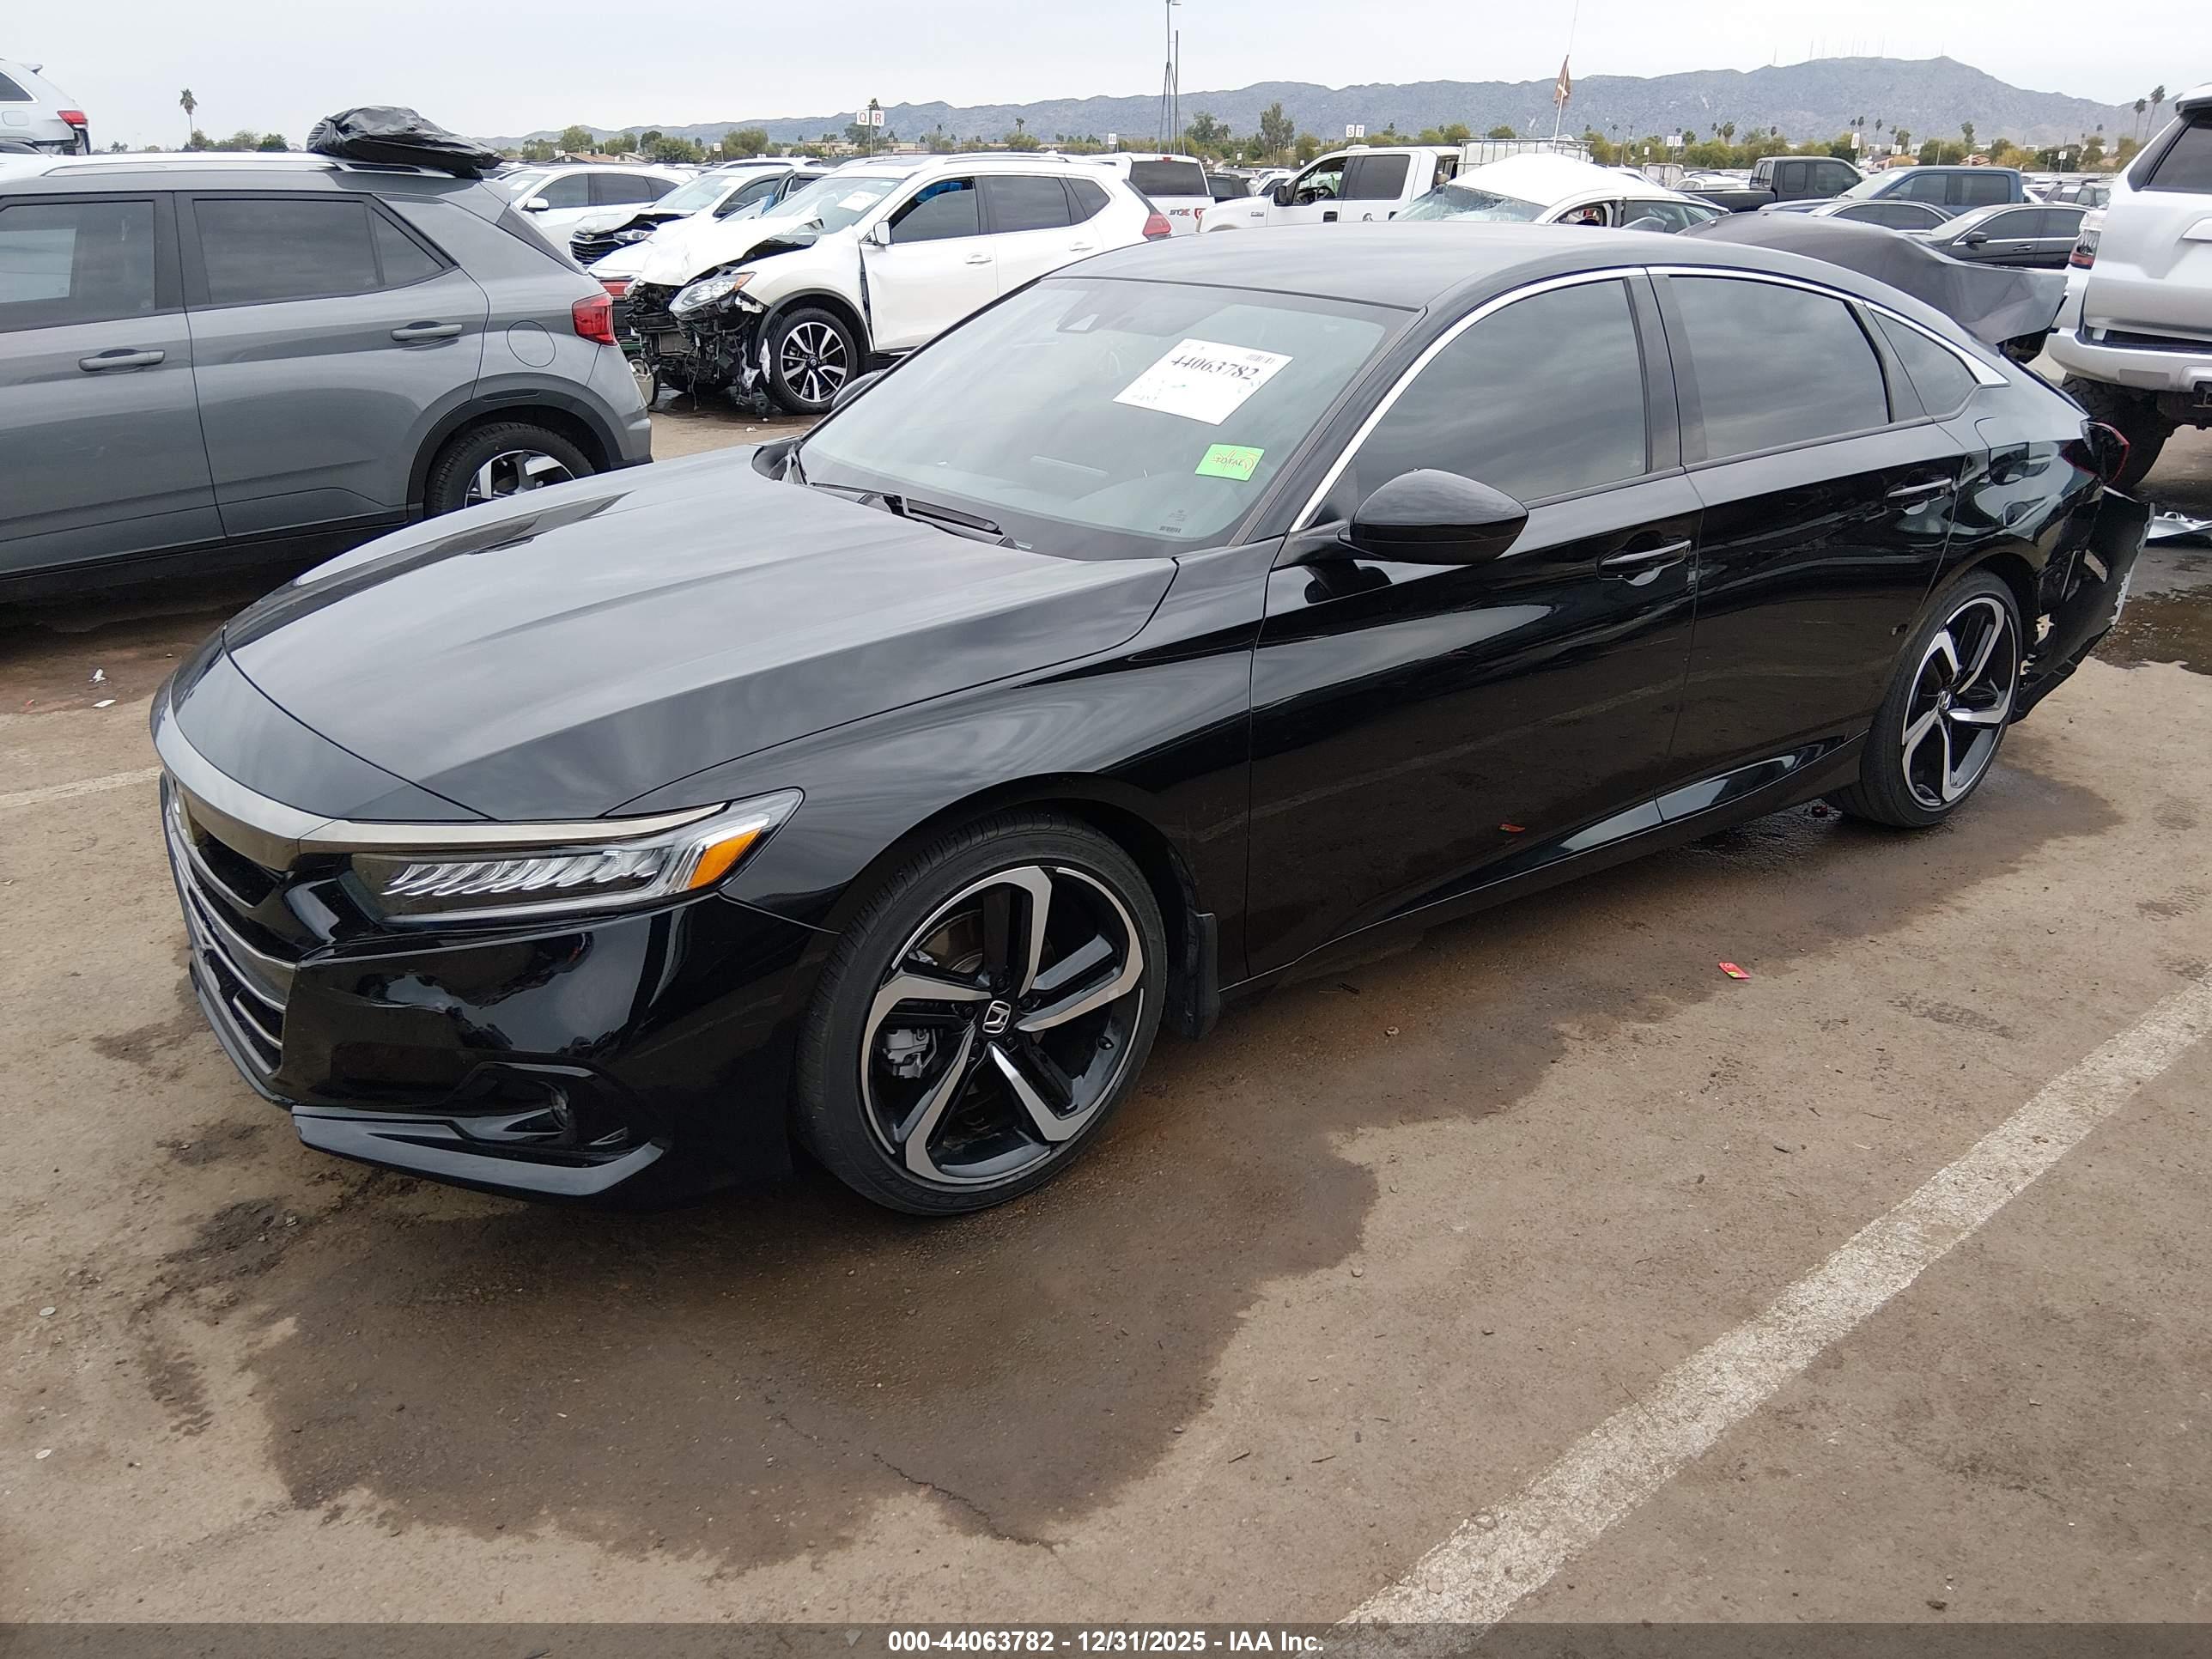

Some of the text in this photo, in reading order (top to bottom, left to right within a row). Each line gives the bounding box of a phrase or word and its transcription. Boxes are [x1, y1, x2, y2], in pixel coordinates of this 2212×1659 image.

[860, 112, 882, 125] Q R
[1170, 355, 1260, 380] 44063782
